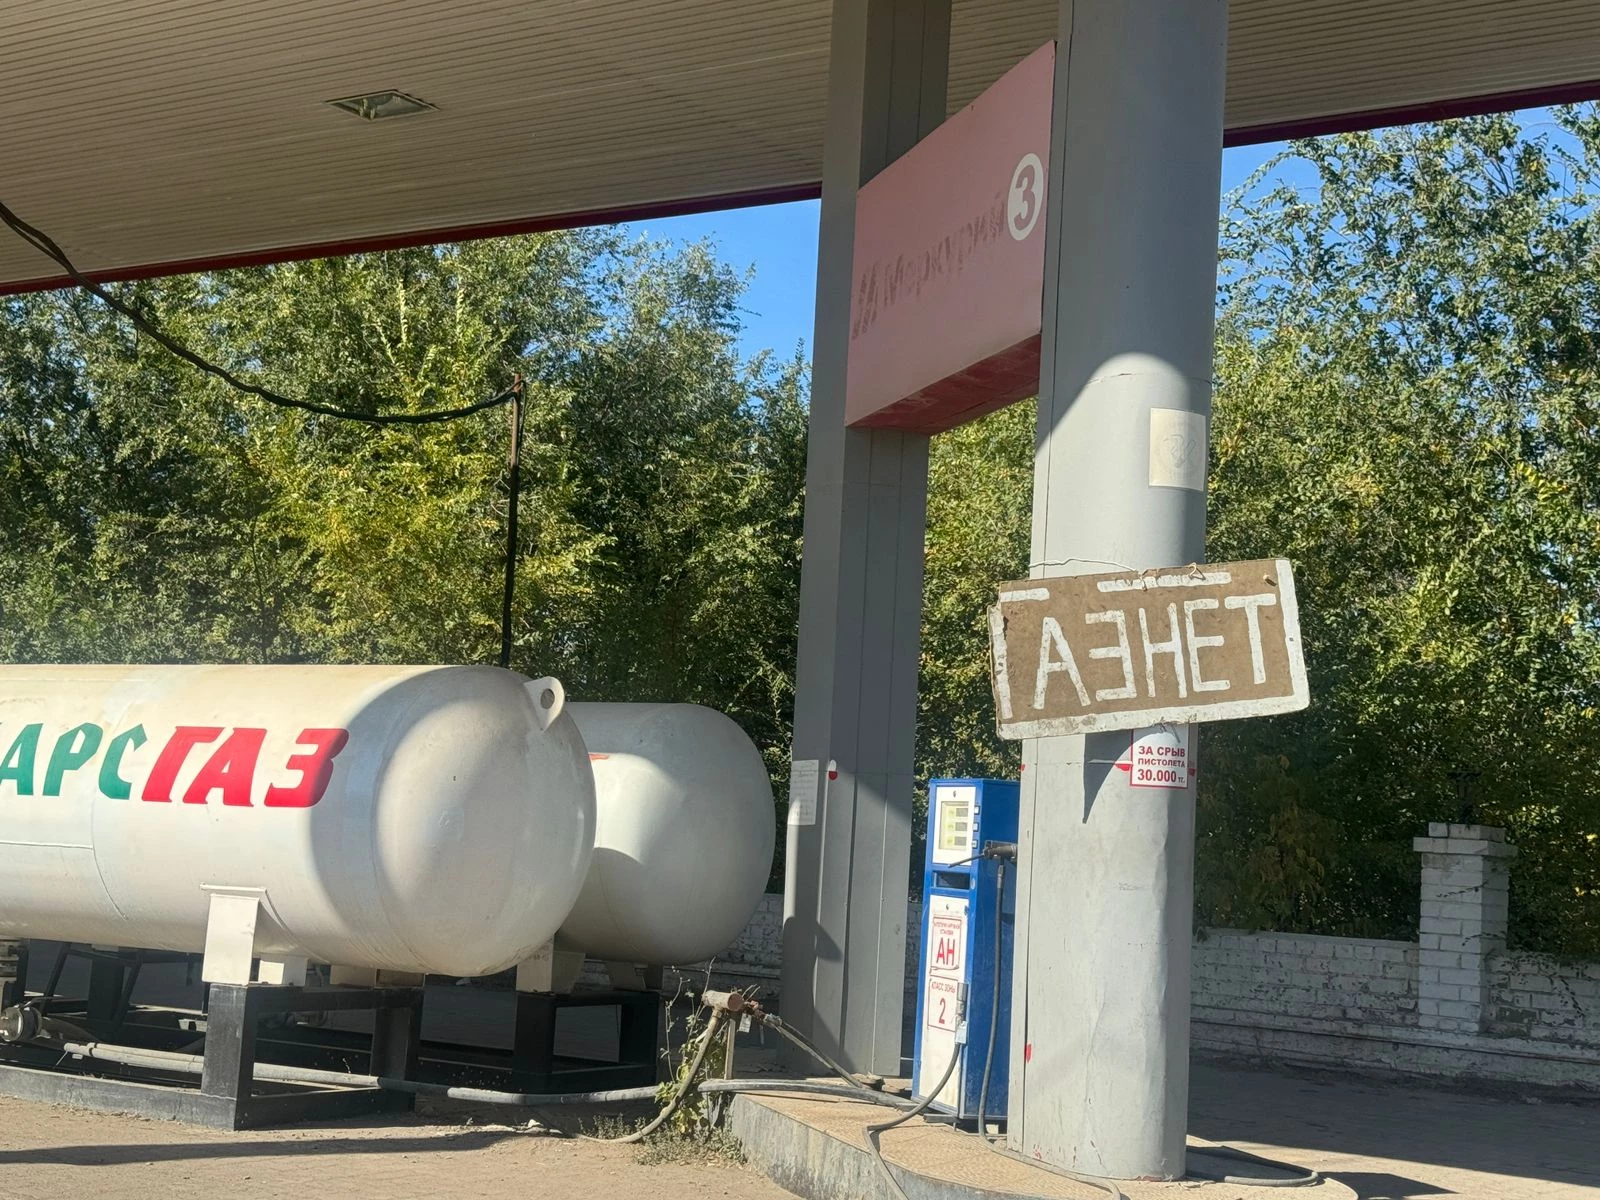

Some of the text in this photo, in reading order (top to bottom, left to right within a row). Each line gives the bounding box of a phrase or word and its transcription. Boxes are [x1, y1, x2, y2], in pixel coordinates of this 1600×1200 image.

[1013, 163, 1036, 232] 3
[0, 722, 349, 808] АРСГАЗ
[1137, 757, 1186, 768] ПИСТОЛЕТА
[1138, 745, 1186, 758] ЗА СРЫВ
[1137, 768, 1177, 783] 30.000
[935, 937, 956, 966] АН
[938, 997, 946, 1025] 2
